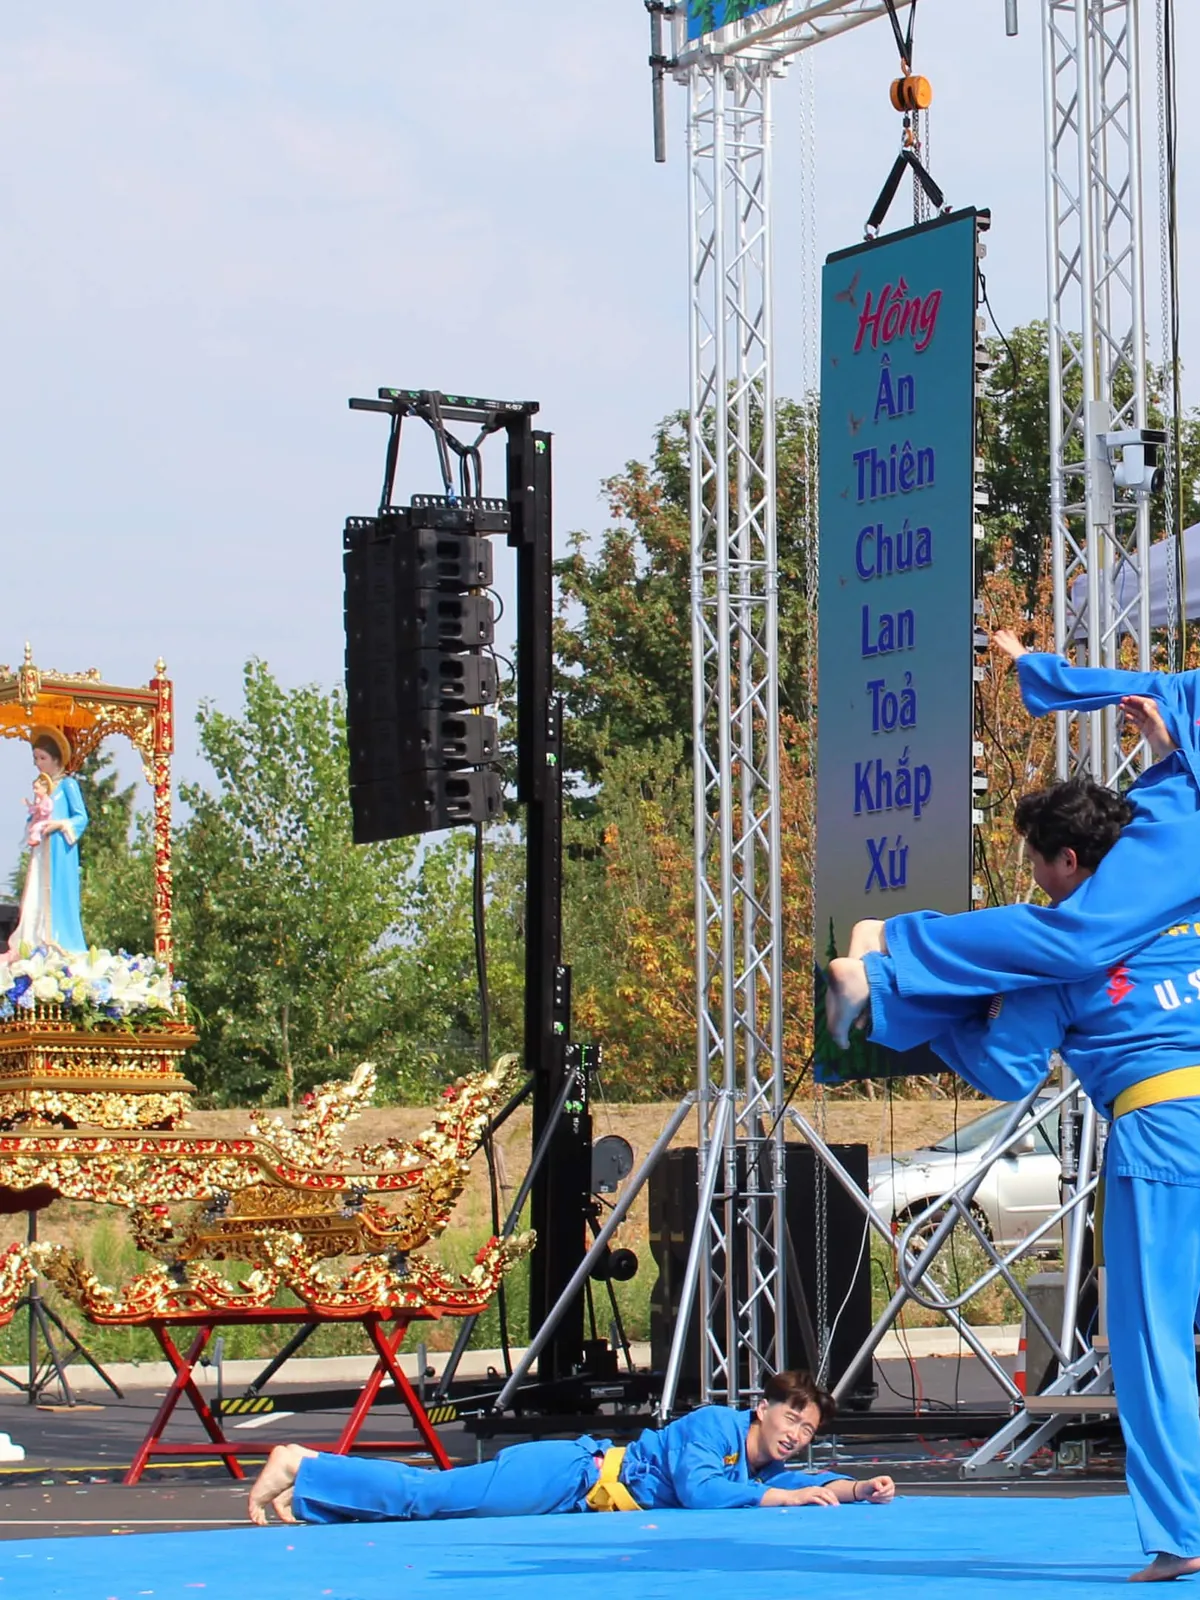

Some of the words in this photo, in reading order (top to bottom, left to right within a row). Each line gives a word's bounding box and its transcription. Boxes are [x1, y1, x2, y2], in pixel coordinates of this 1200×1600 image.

[853, 275, 943, 352] Hồng
[873, 352, 914, 422] Ân
[853, 439, 935, 502] Thiên
[855, 518, 933, 580] Chúa
[861, 603, 915, 658] Lan
[866, 671, 917, 733] Toả
[853, 744, 932, 820] Khắp
[864, 834, 910, 892] Xứ
